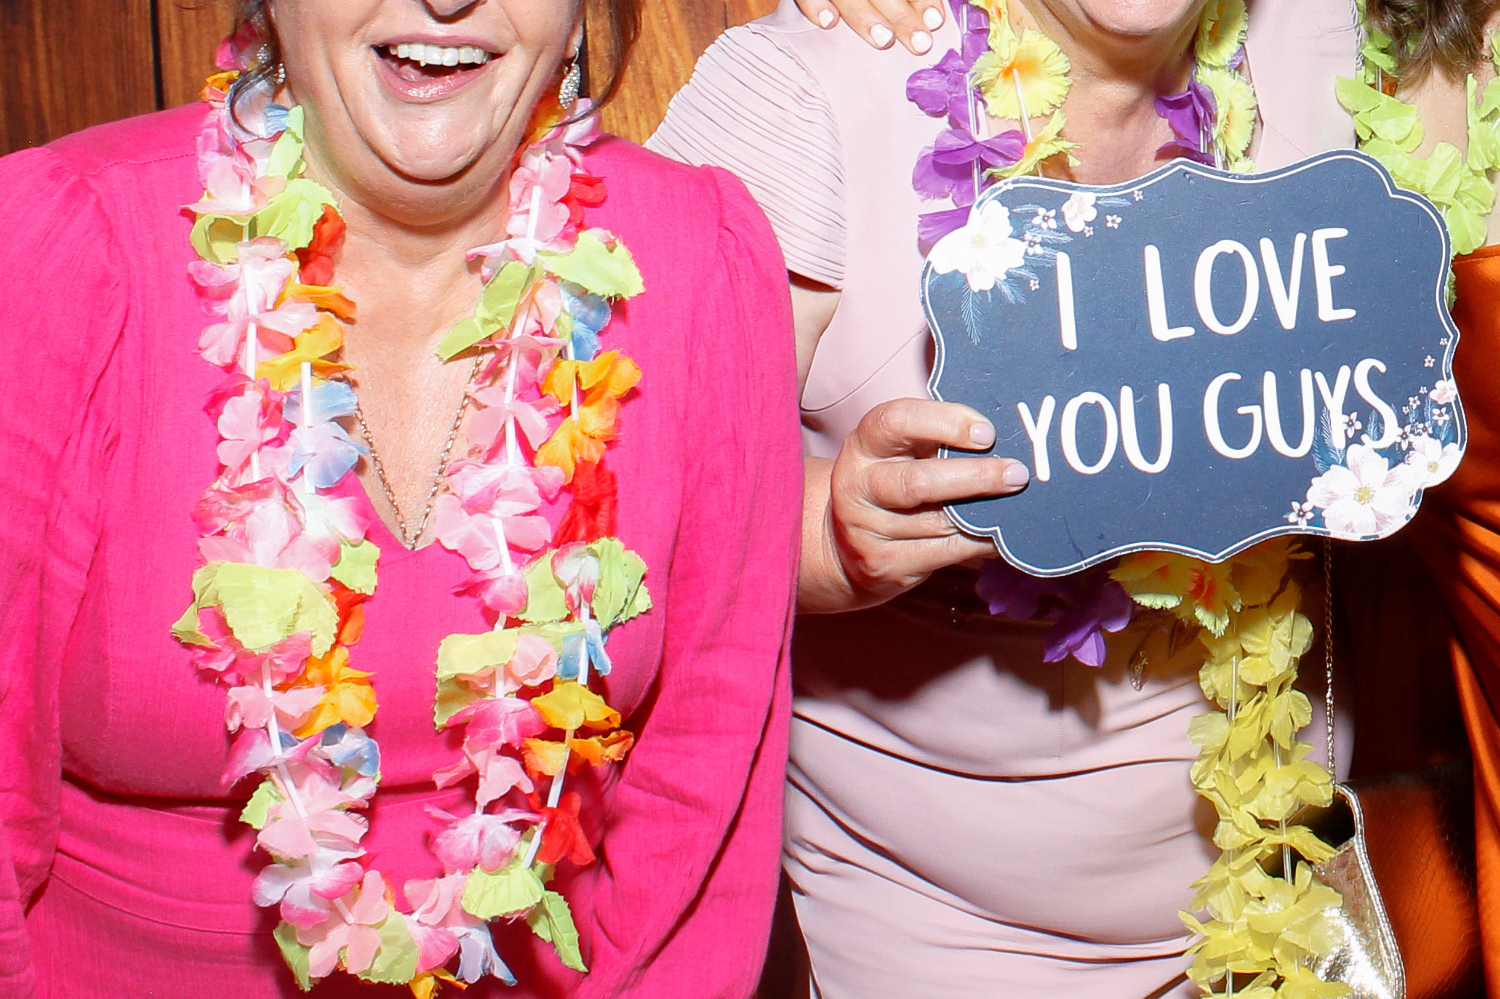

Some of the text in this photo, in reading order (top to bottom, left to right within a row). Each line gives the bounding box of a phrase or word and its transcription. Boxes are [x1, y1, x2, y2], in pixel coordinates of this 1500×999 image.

[1055, 227, 1357, 351] I LOVE
[1017, 358, 1399, 483] YOU GUYS
